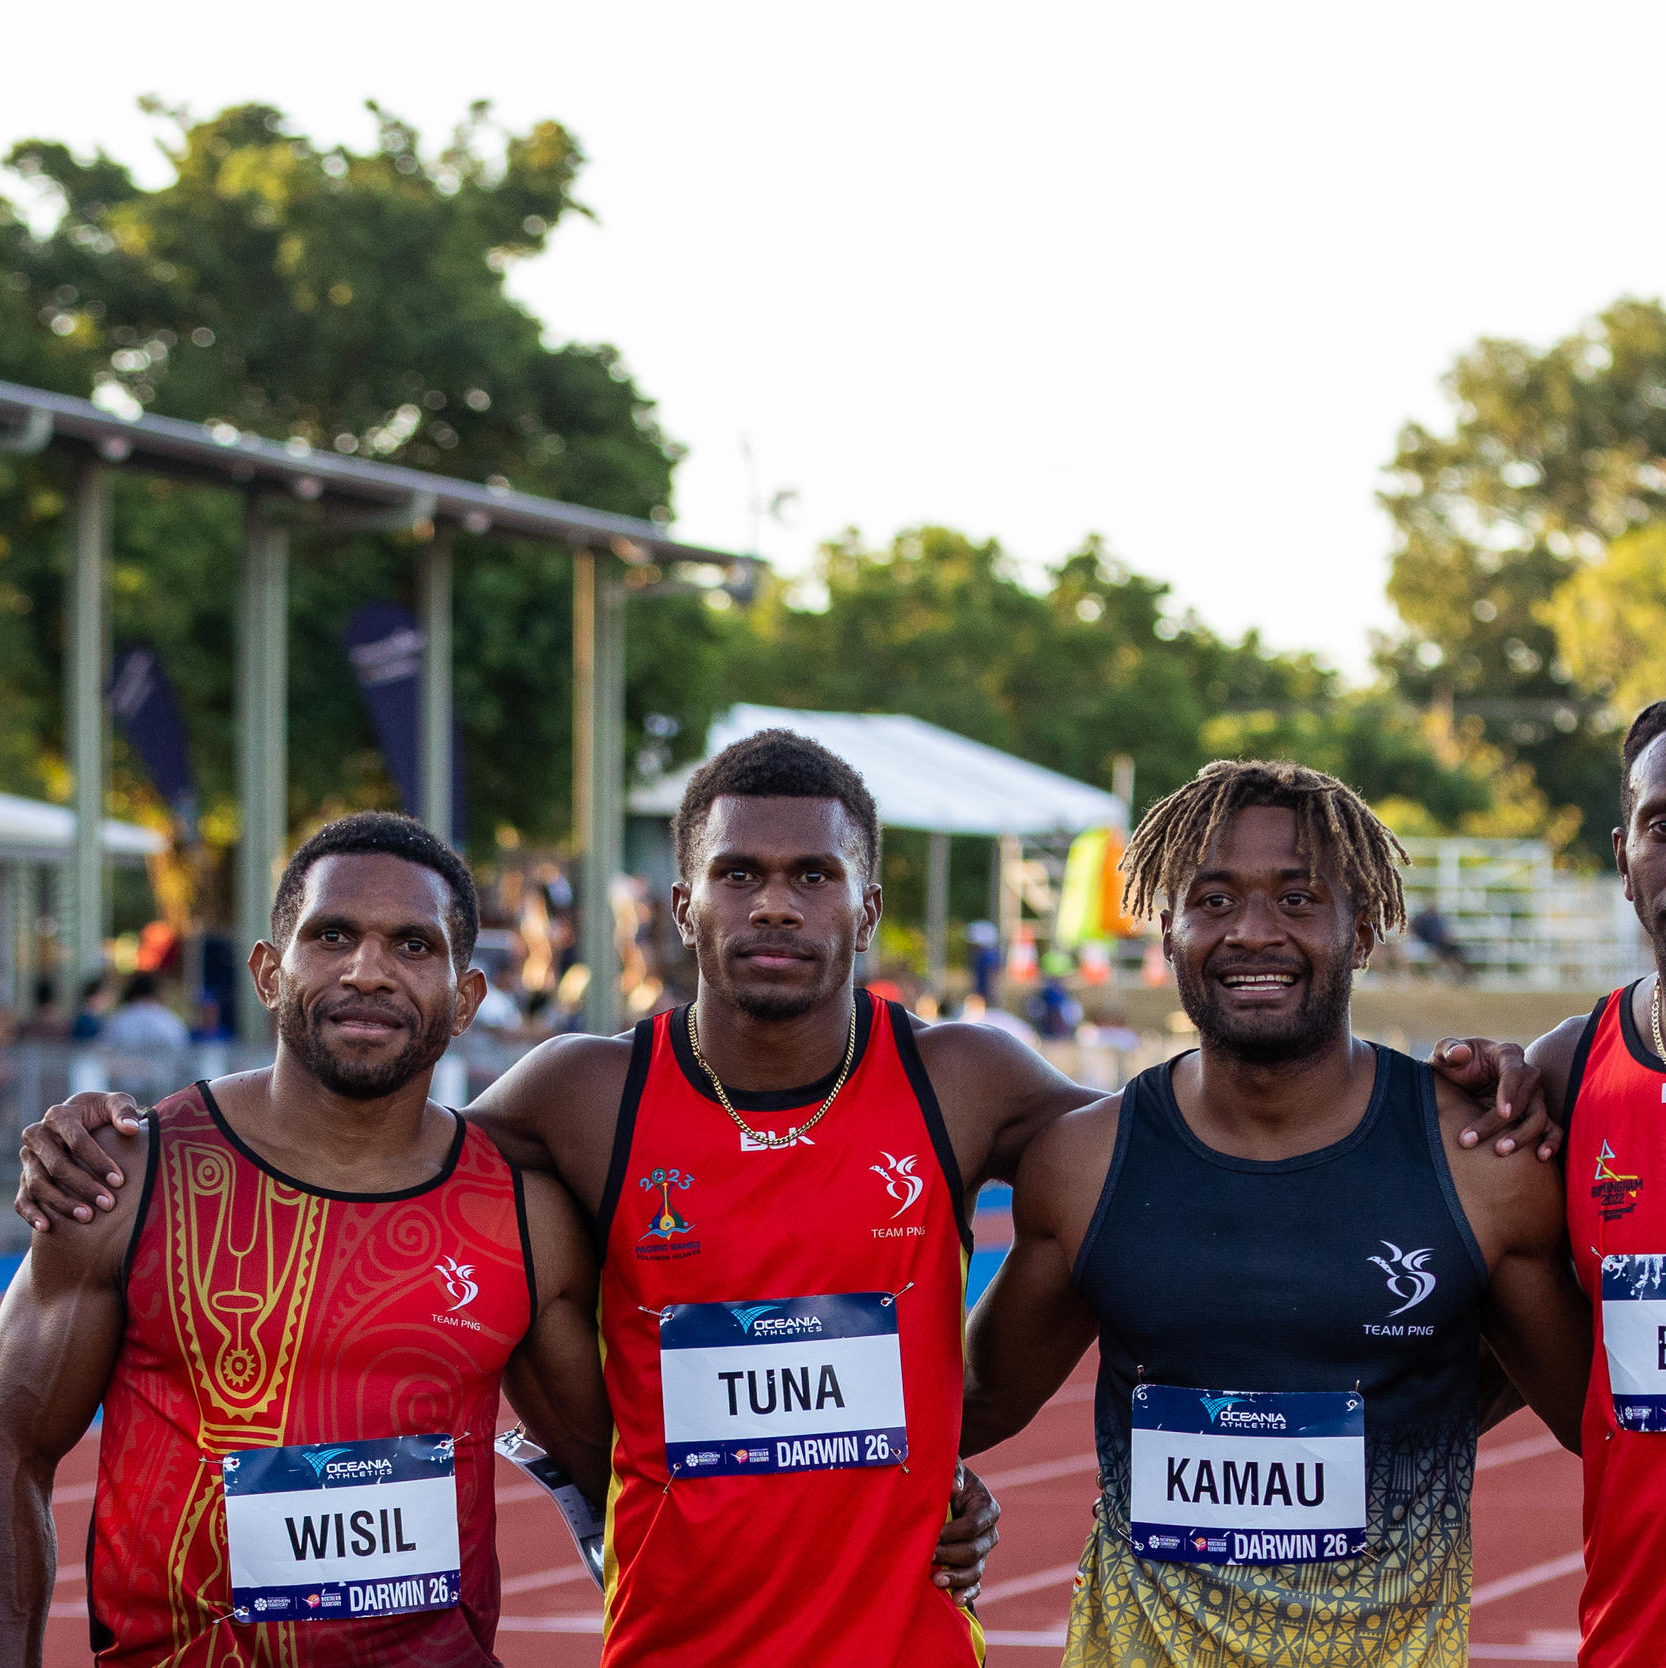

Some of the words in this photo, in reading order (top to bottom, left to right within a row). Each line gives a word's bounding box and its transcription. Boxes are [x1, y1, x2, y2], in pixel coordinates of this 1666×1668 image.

[740, 1127, 815, 1152] BLK
[639, 1168, 695, 1192] 2023
[871, 1227, 904, 1238] TEAM
[431, 1313, 459, 1327] TEAM
[461, 1320, 481, 1331] PNG
[753, 1316, 822, 1331] OCEANIA
[1363, 1324, 1404, 1336] TEAM
[1407, 1325, 1435, 1336] PNG
[754, 1326, 823, 1337] ATHLETICS
[718, 1364, 846, 1416] TUNA
[1220, 1410, 1286, 1423] OCEANIA
[1220, 1421, 1287, 1430] ATHLETICS
[776, 1436, 858, 1468] DARWIN
[864, 1433, 890, 1461] 26
[326, 1458, 393, 1474] OCEANIA
[327, 1469, 393, 1480] ATHLETICS
[1166, 1456, 1325, 1507] KAMAU
[284, 1507, 417, 1561] WISIL
[1234, 1534, 1316, 1560] DARWIN
[1323, 1533, 1348, 1557] 26
[349, 1580, 425, 1612] DARWIN
[429, 1576, 449, 1605] 26
